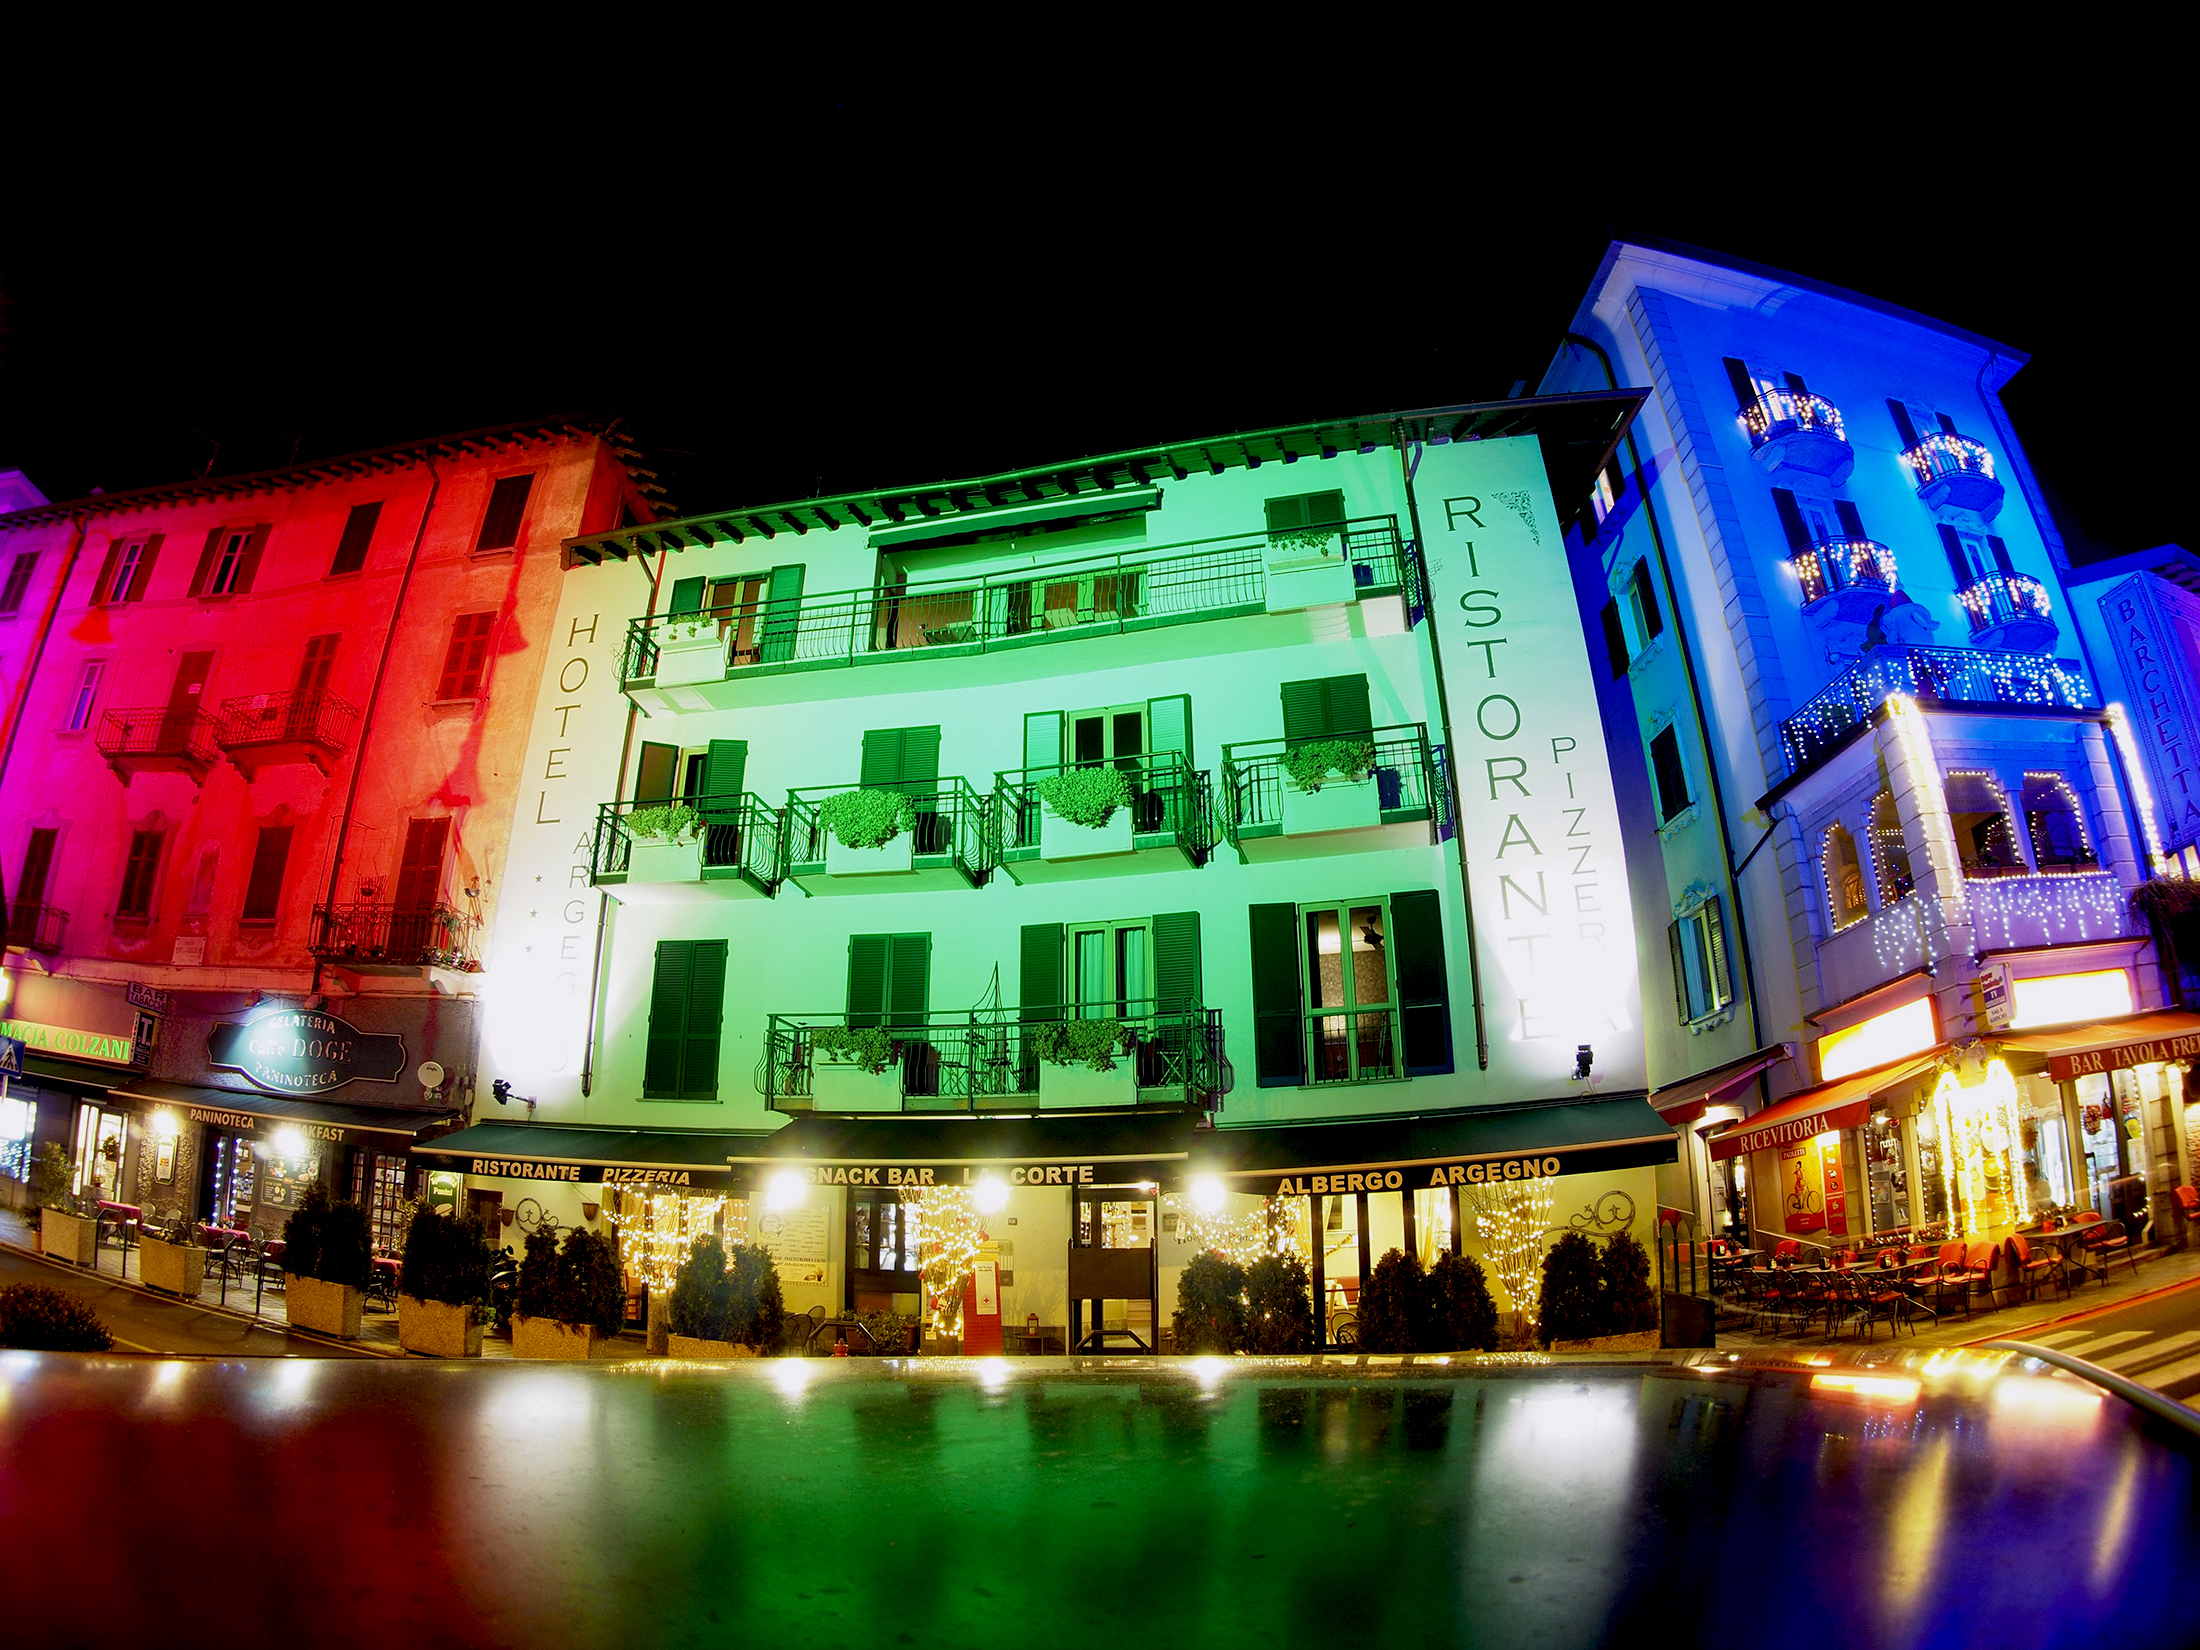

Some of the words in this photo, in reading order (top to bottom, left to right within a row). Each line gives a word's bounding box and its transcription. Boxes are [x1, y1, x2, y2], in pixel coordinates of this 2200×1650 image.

[535, 613, 600, 826] HOTEL
[2117, 598, 2200, 824] BARCHETTA
[1442, 495, 1559, 1041] RISTORANTE
[1550, 735, 1619, 1032] PIZZERA
[130, 991, 167, 1013] TABACCHI
[132, 983, 166, 1001] BAR
[268, 1014, 336, 1035] GELATERIA
[0, 1021, 48, 1048] MACIA
[54, 1030, 131, 1061] COLZANI
[291, 1037, 353, 1064] DOGE
[255, 1061, 338, 1088] PANINOTECA
[2069, 1050, 2105, 1076] BAR
[2110, 1042, 2170, 1068] TAVOLA
[190, 1108, 255, 1130] PANINOTECA
[1739, 1113, 1830, 1153] RICEVITORIA
[472, 1158, 581, 1182] RISTORANTE
[601, 1167, 691, 1186] PIZZERIA
[804, 1166, 881, 1185] SNACK
[887, 1167, 935, 1185] BAR
[1010, 1165, 1094, 1185] CORTE
[1277, 1170, 1403, 1195] ALBERGO
[1429, 1156, 1561, 1187] ARGEGNO
